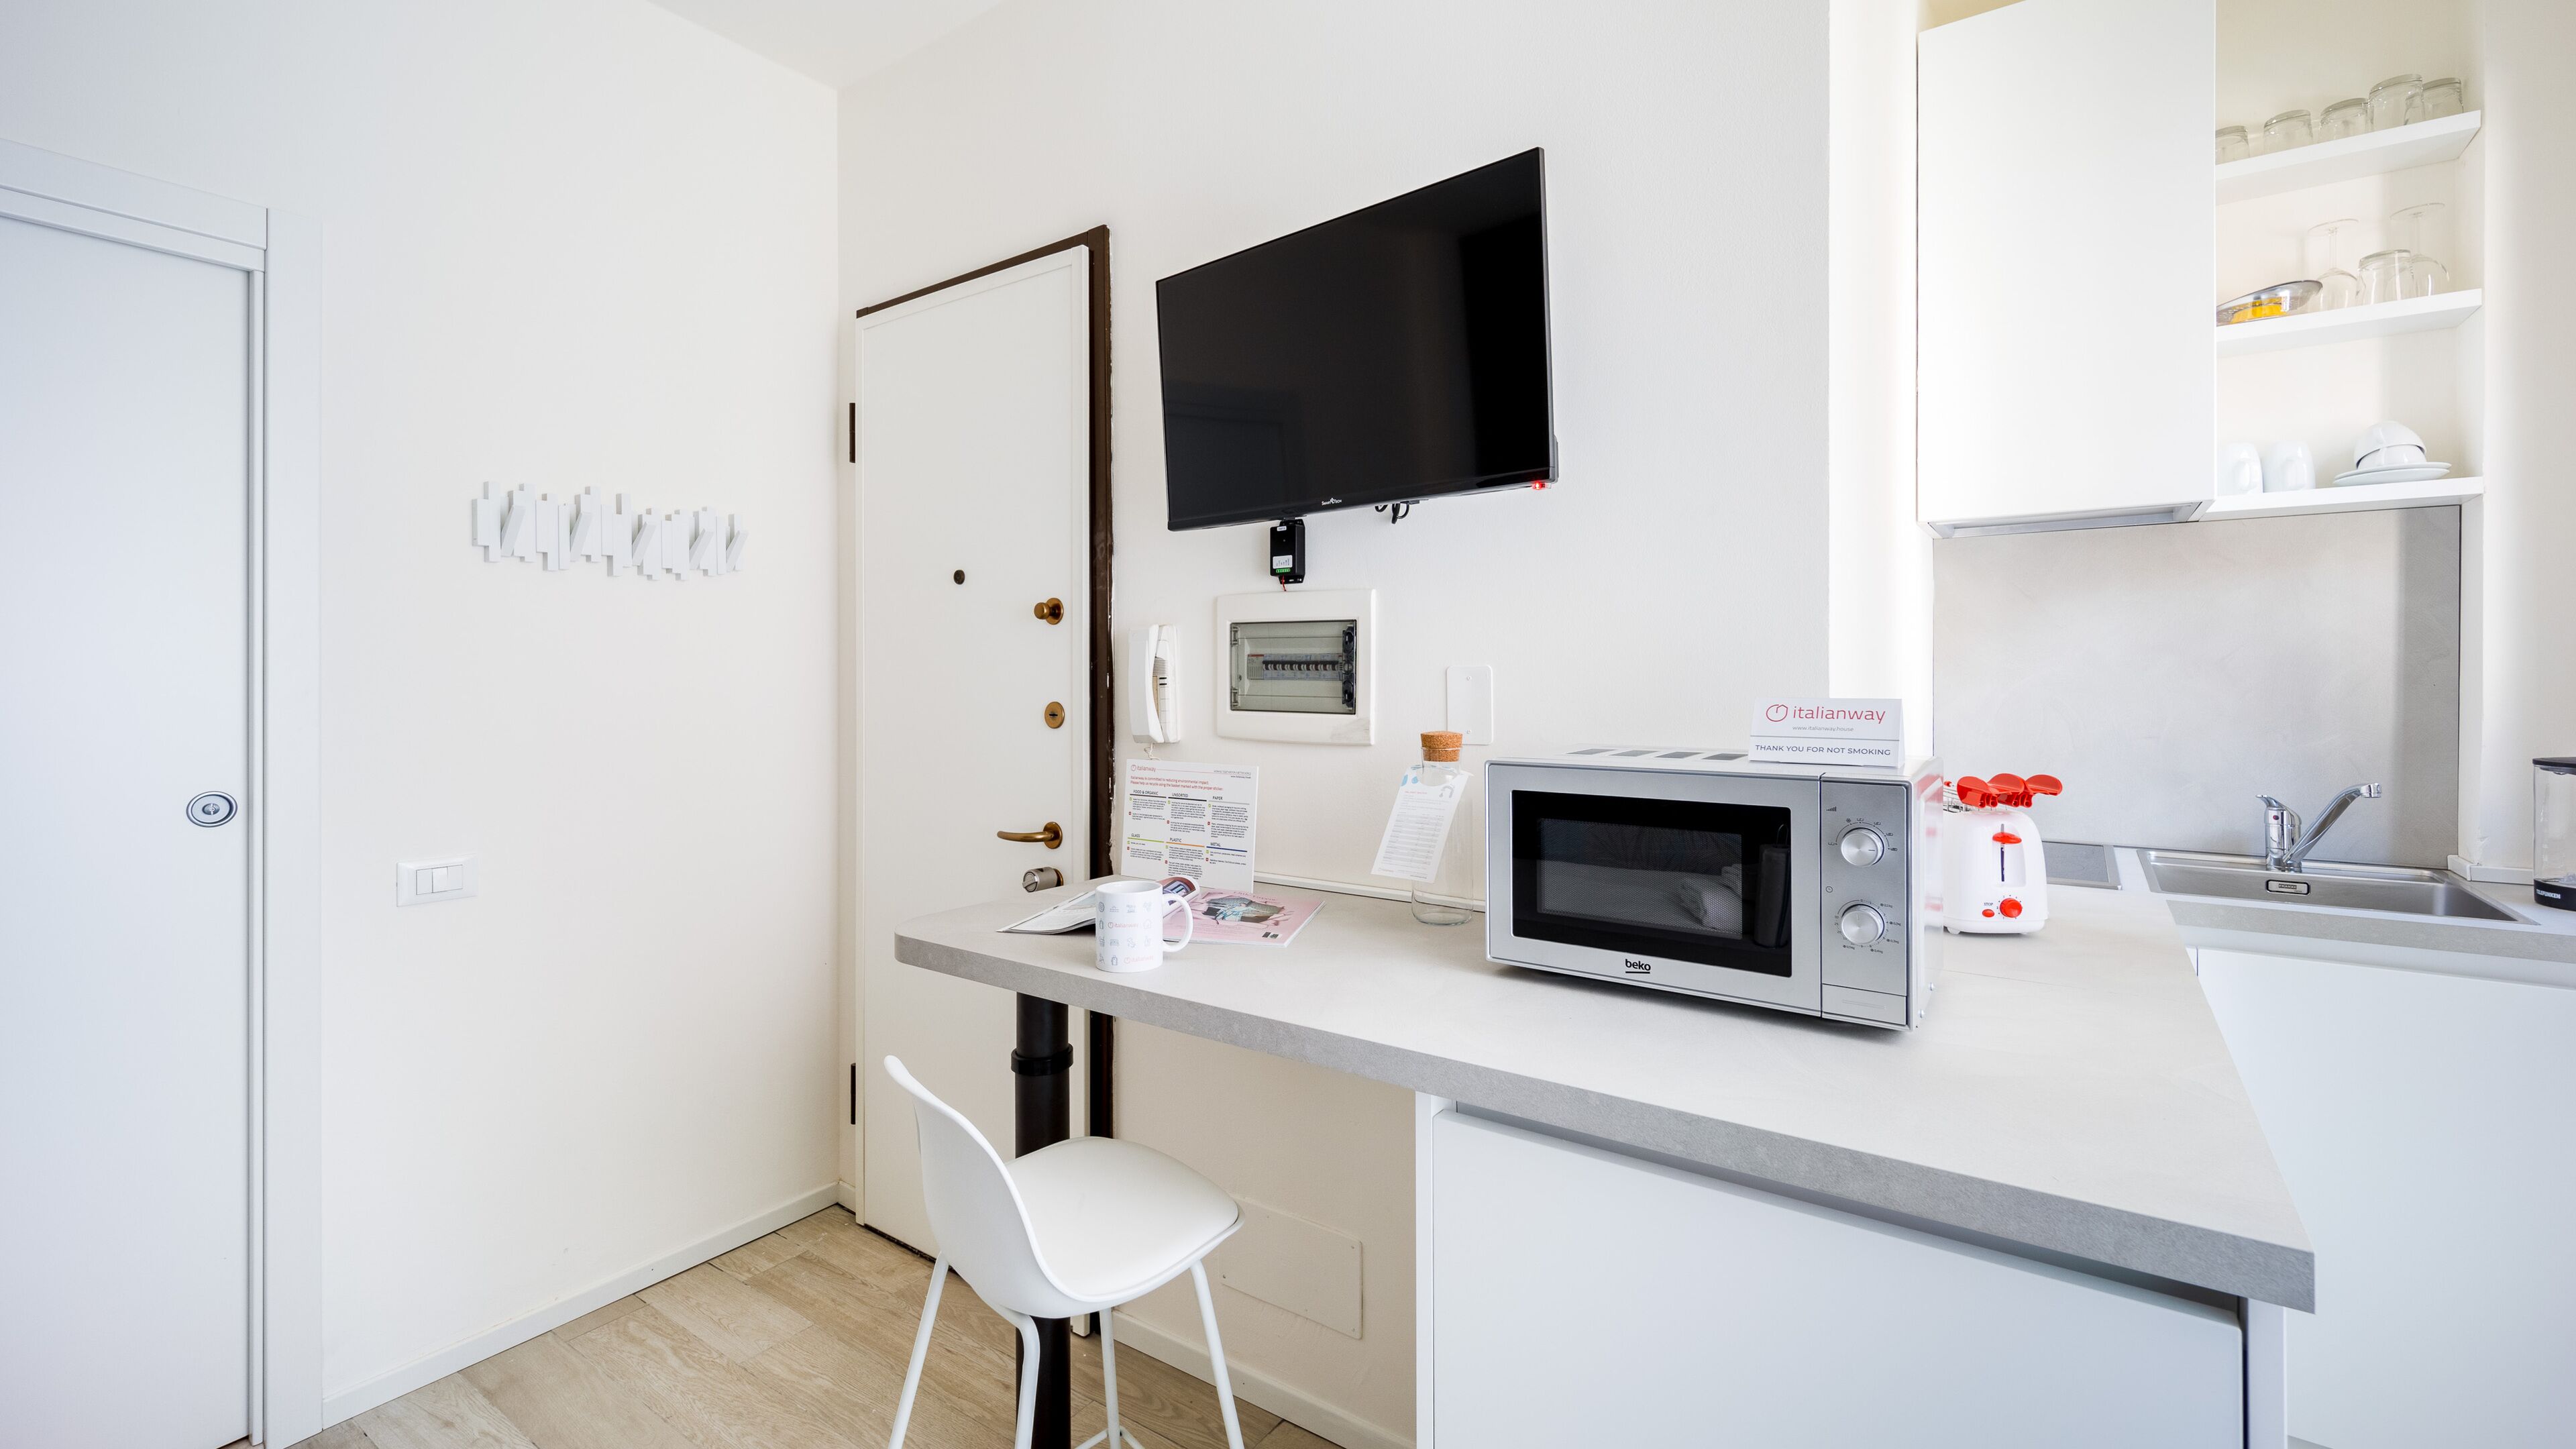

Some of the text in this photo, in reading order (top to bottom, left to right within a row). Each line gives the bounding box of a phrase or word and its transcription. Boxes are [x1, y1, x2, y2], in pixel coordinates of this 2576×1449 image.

[1793, 706, 1886, 724] italianway
[2536, 889, 2561, 899] TELEFUNKEN
[1625, 959, 1651, 971] beko
